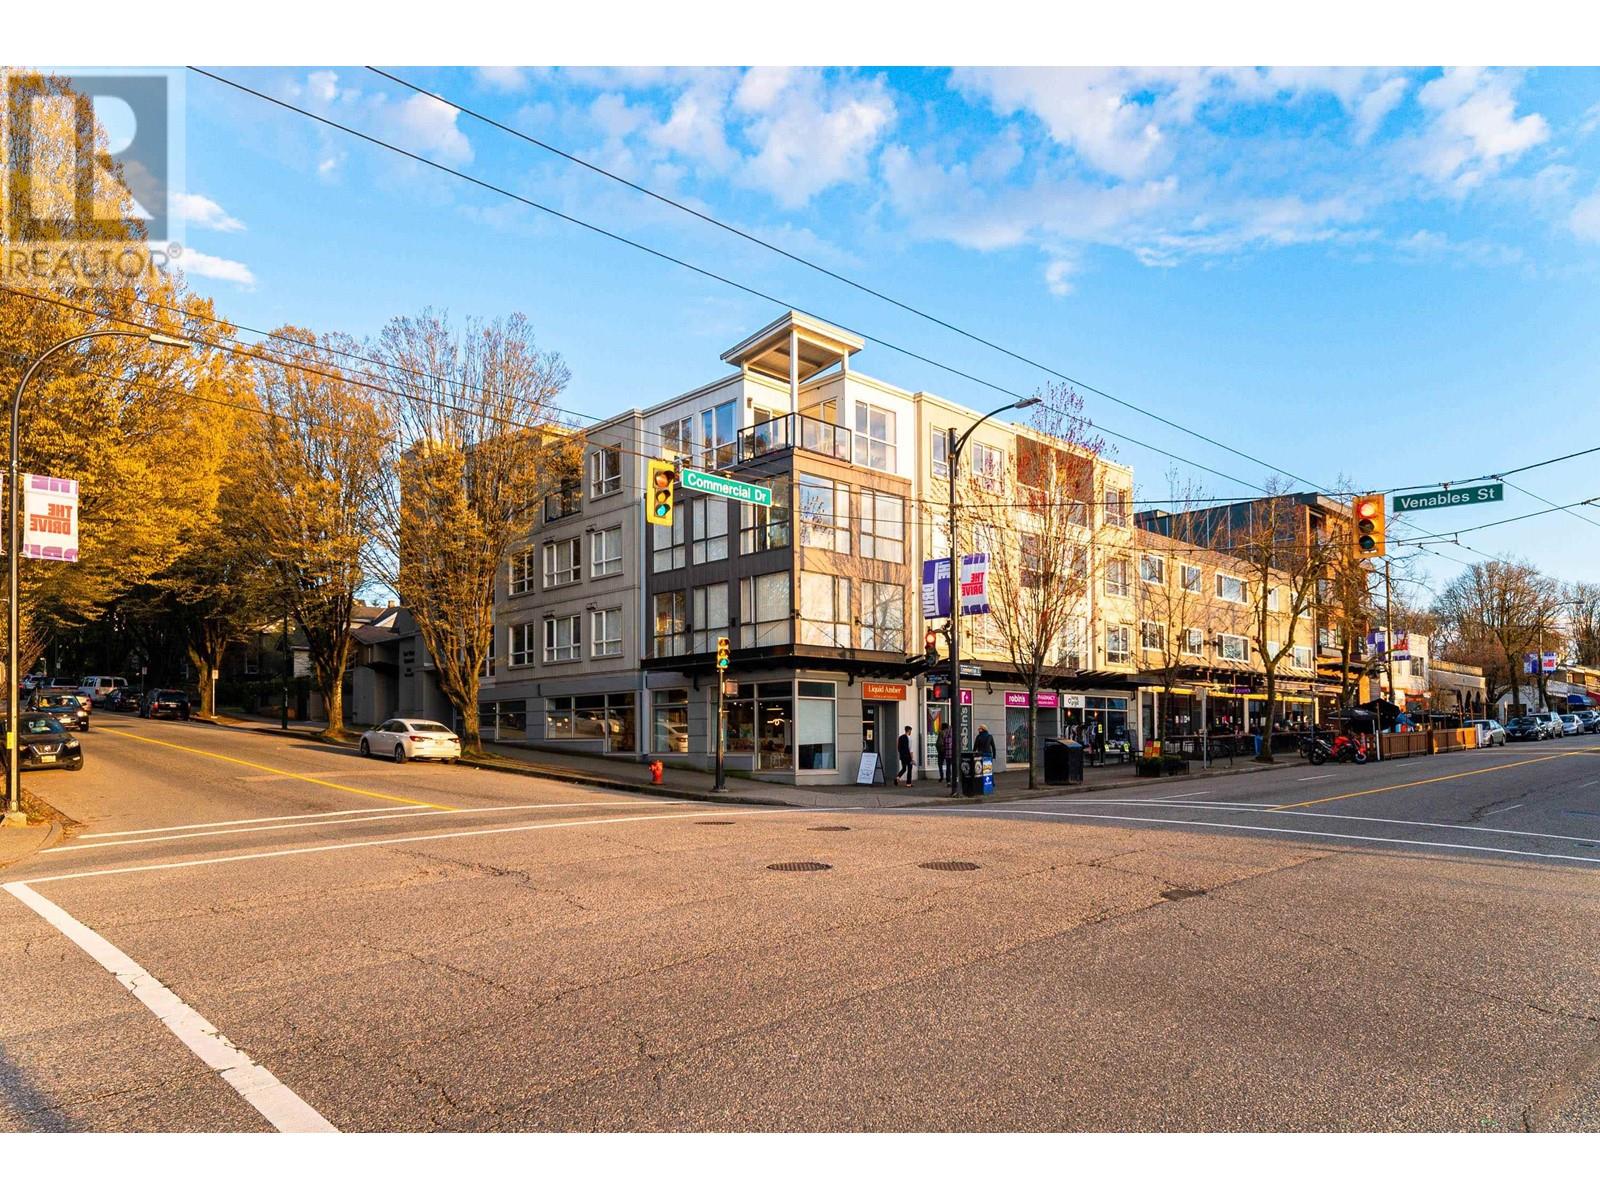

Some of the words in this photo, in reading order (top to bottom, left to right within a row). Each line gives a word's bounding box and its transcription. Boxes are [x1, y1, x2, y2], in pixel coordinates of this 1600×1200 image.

[687, 473, 751, 500] Commercial
[754, 490, 766, 503] Dr
[1401, 492, 1470, 509] Venables
[1477, 488, 1496, 500] St
[868, 684, 884, 695] Liquid
[885, 685, 902, 694] Amber
